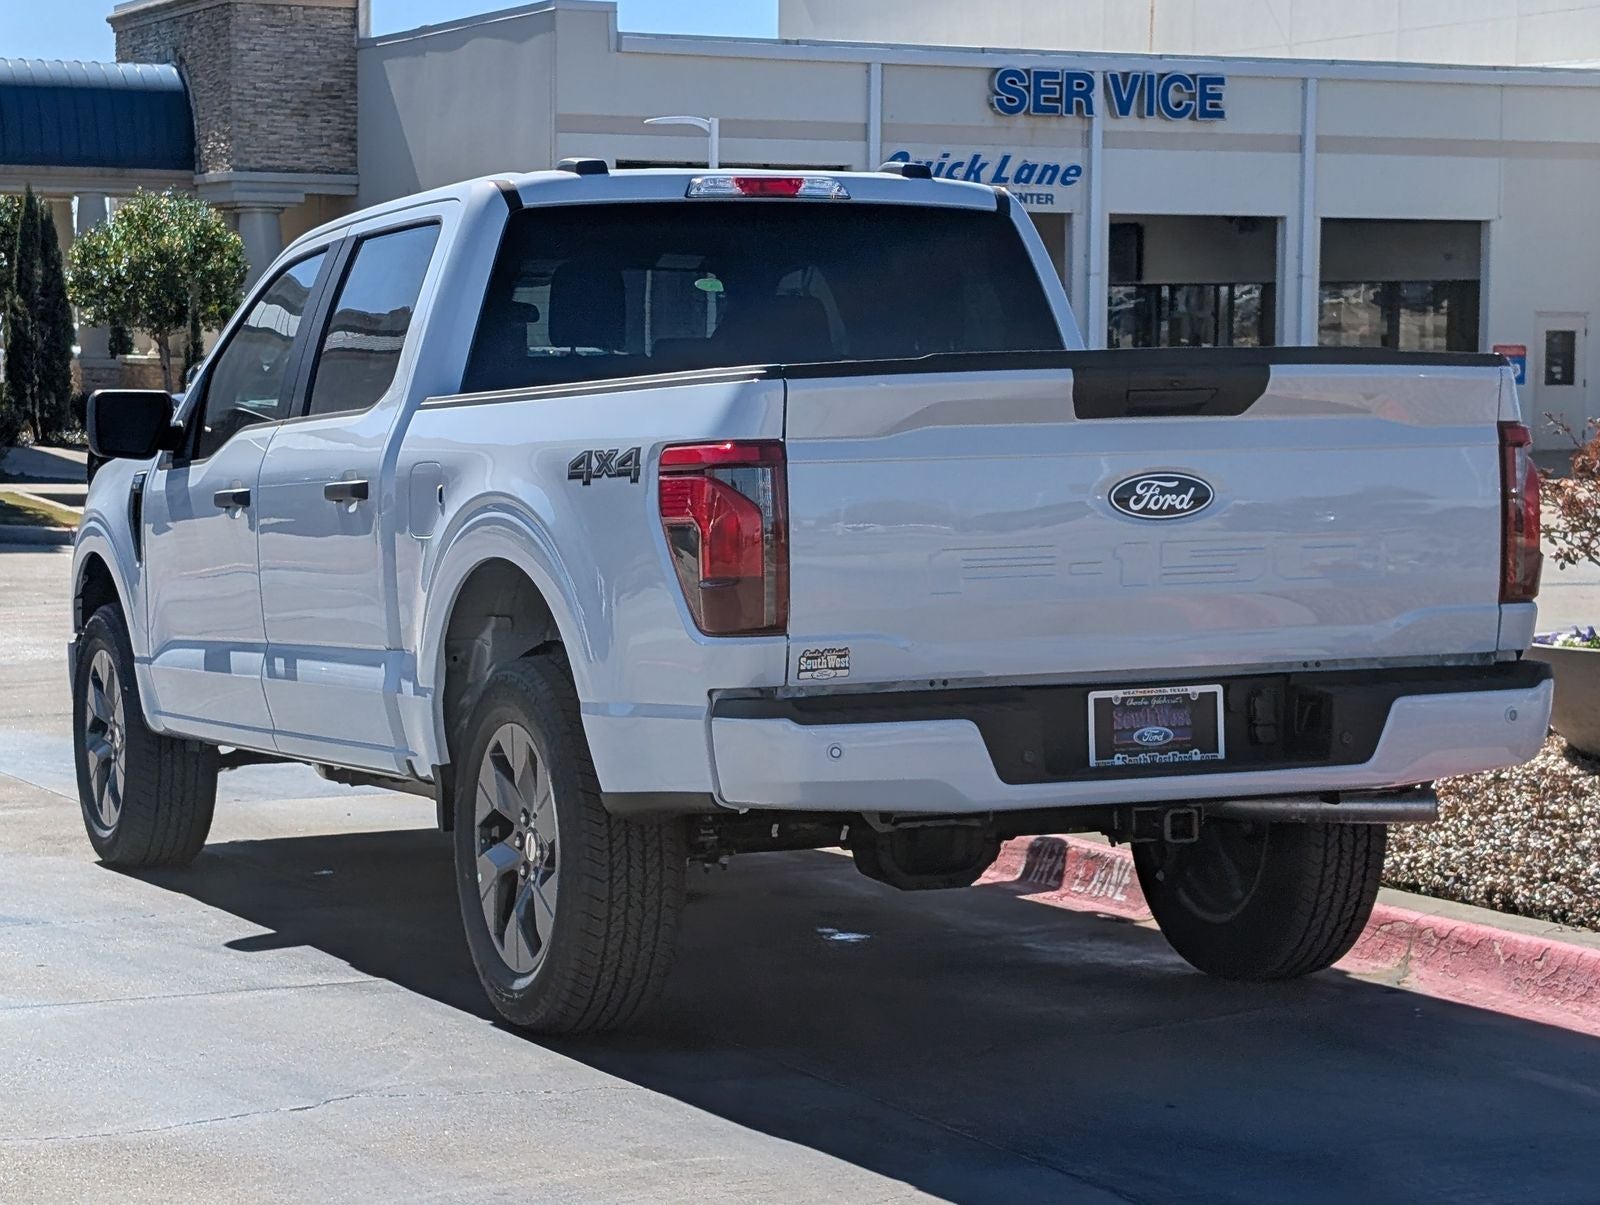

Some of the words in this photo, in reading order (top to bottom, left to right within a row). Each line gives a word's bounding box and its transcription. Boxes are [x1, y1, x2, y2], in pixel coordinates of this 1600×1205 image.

[993, 67, 1226, 121] SERVICE
[991, 154, 1083, 187] Lane
[1128, 480, 1195, 511] Ford
[1142, 729, 1165, 742] Ford
